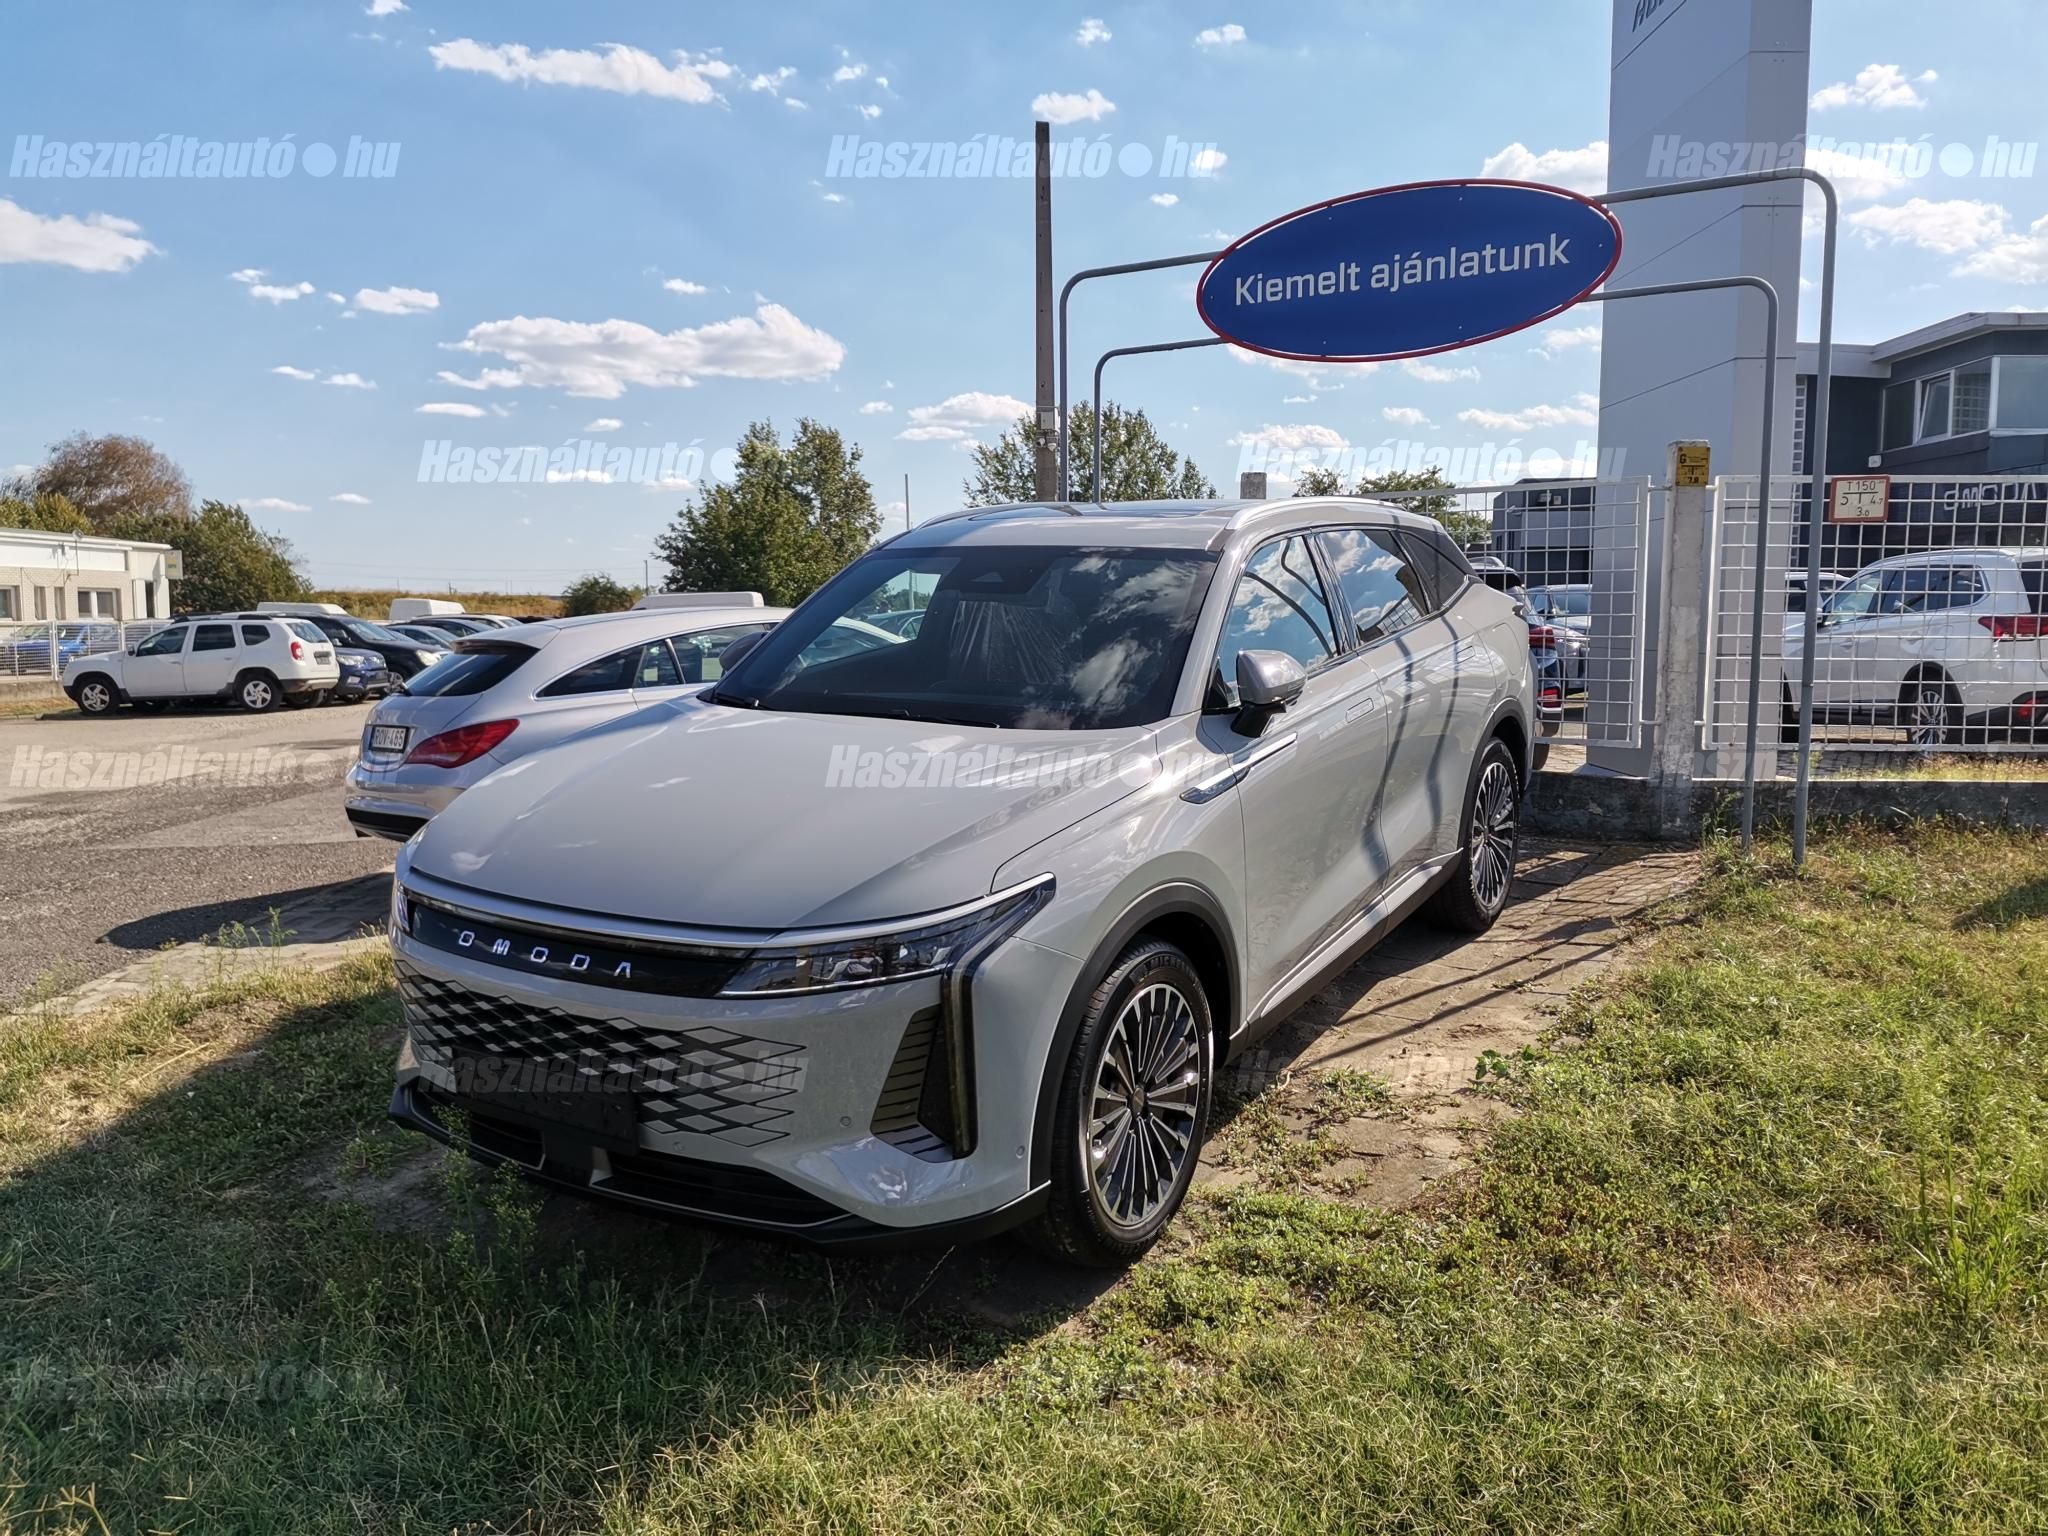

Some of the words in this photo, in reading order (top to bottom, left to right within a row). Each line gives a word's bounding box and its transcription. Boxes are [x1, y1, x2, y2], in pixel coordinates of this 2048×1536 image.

[1236, 262, 1361, 306] Kiemelt
[1370, 233, 1571, 292] ajánlatunk
[458, 930, 632, 979] OMODA
